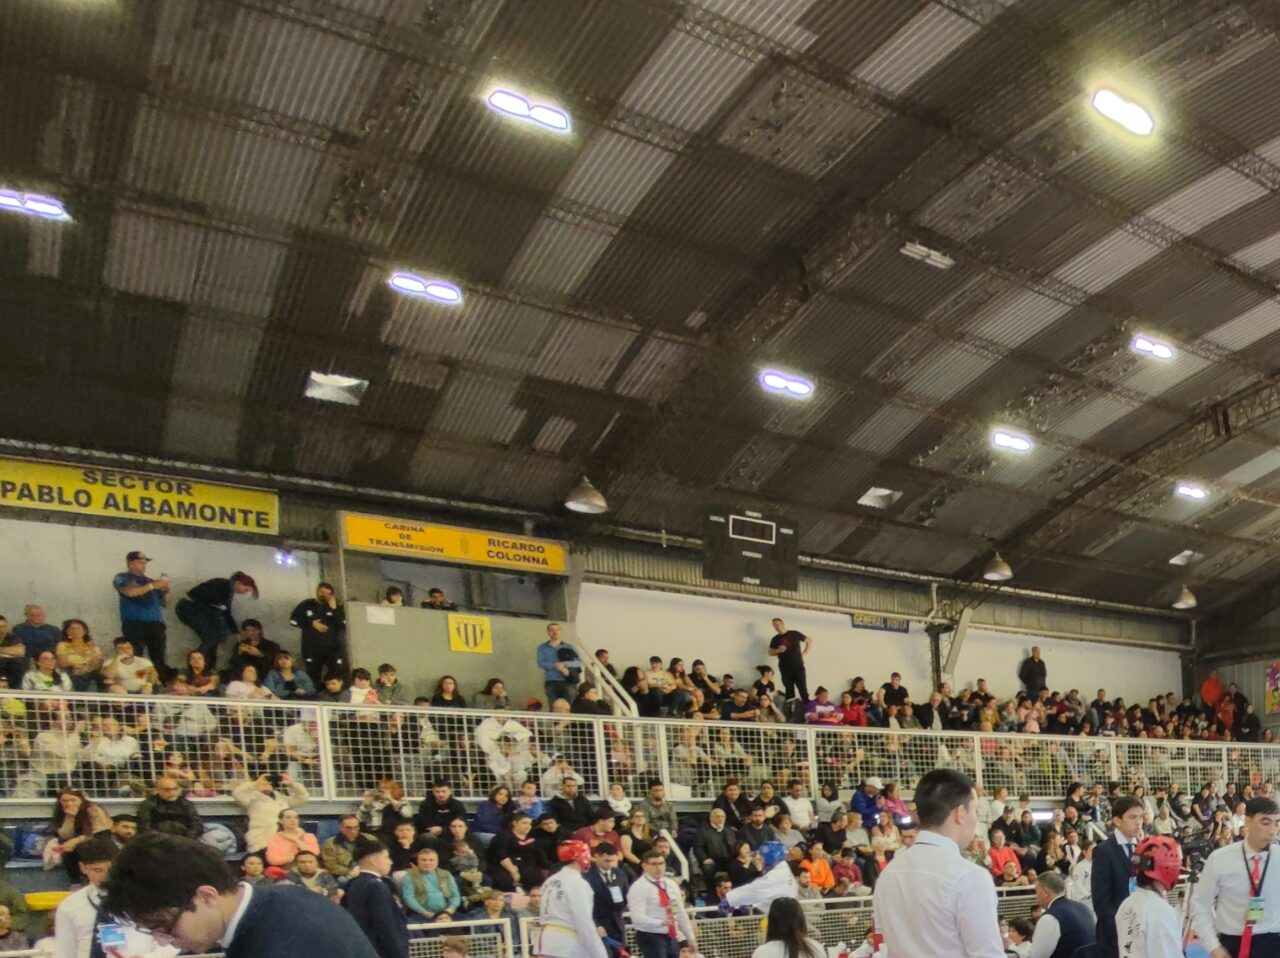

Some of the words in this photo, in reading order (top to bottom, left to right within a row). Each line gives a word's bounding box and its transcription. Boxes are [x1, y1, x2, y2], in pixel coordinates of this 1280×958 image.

[83, 469, 194, 497] SECTOR
[0, 480, 92, 508] PABLO
[103, 492, 271, 529] ALBAMONTE
[383, 522, 425, 534] CABINA
[398, 532, 413, 541] DE
[367, 537, 445, 554] TRANSMISION
[487, 537, 546, 554] RICARDO
[486, 549, 549, 566] COLONNA
